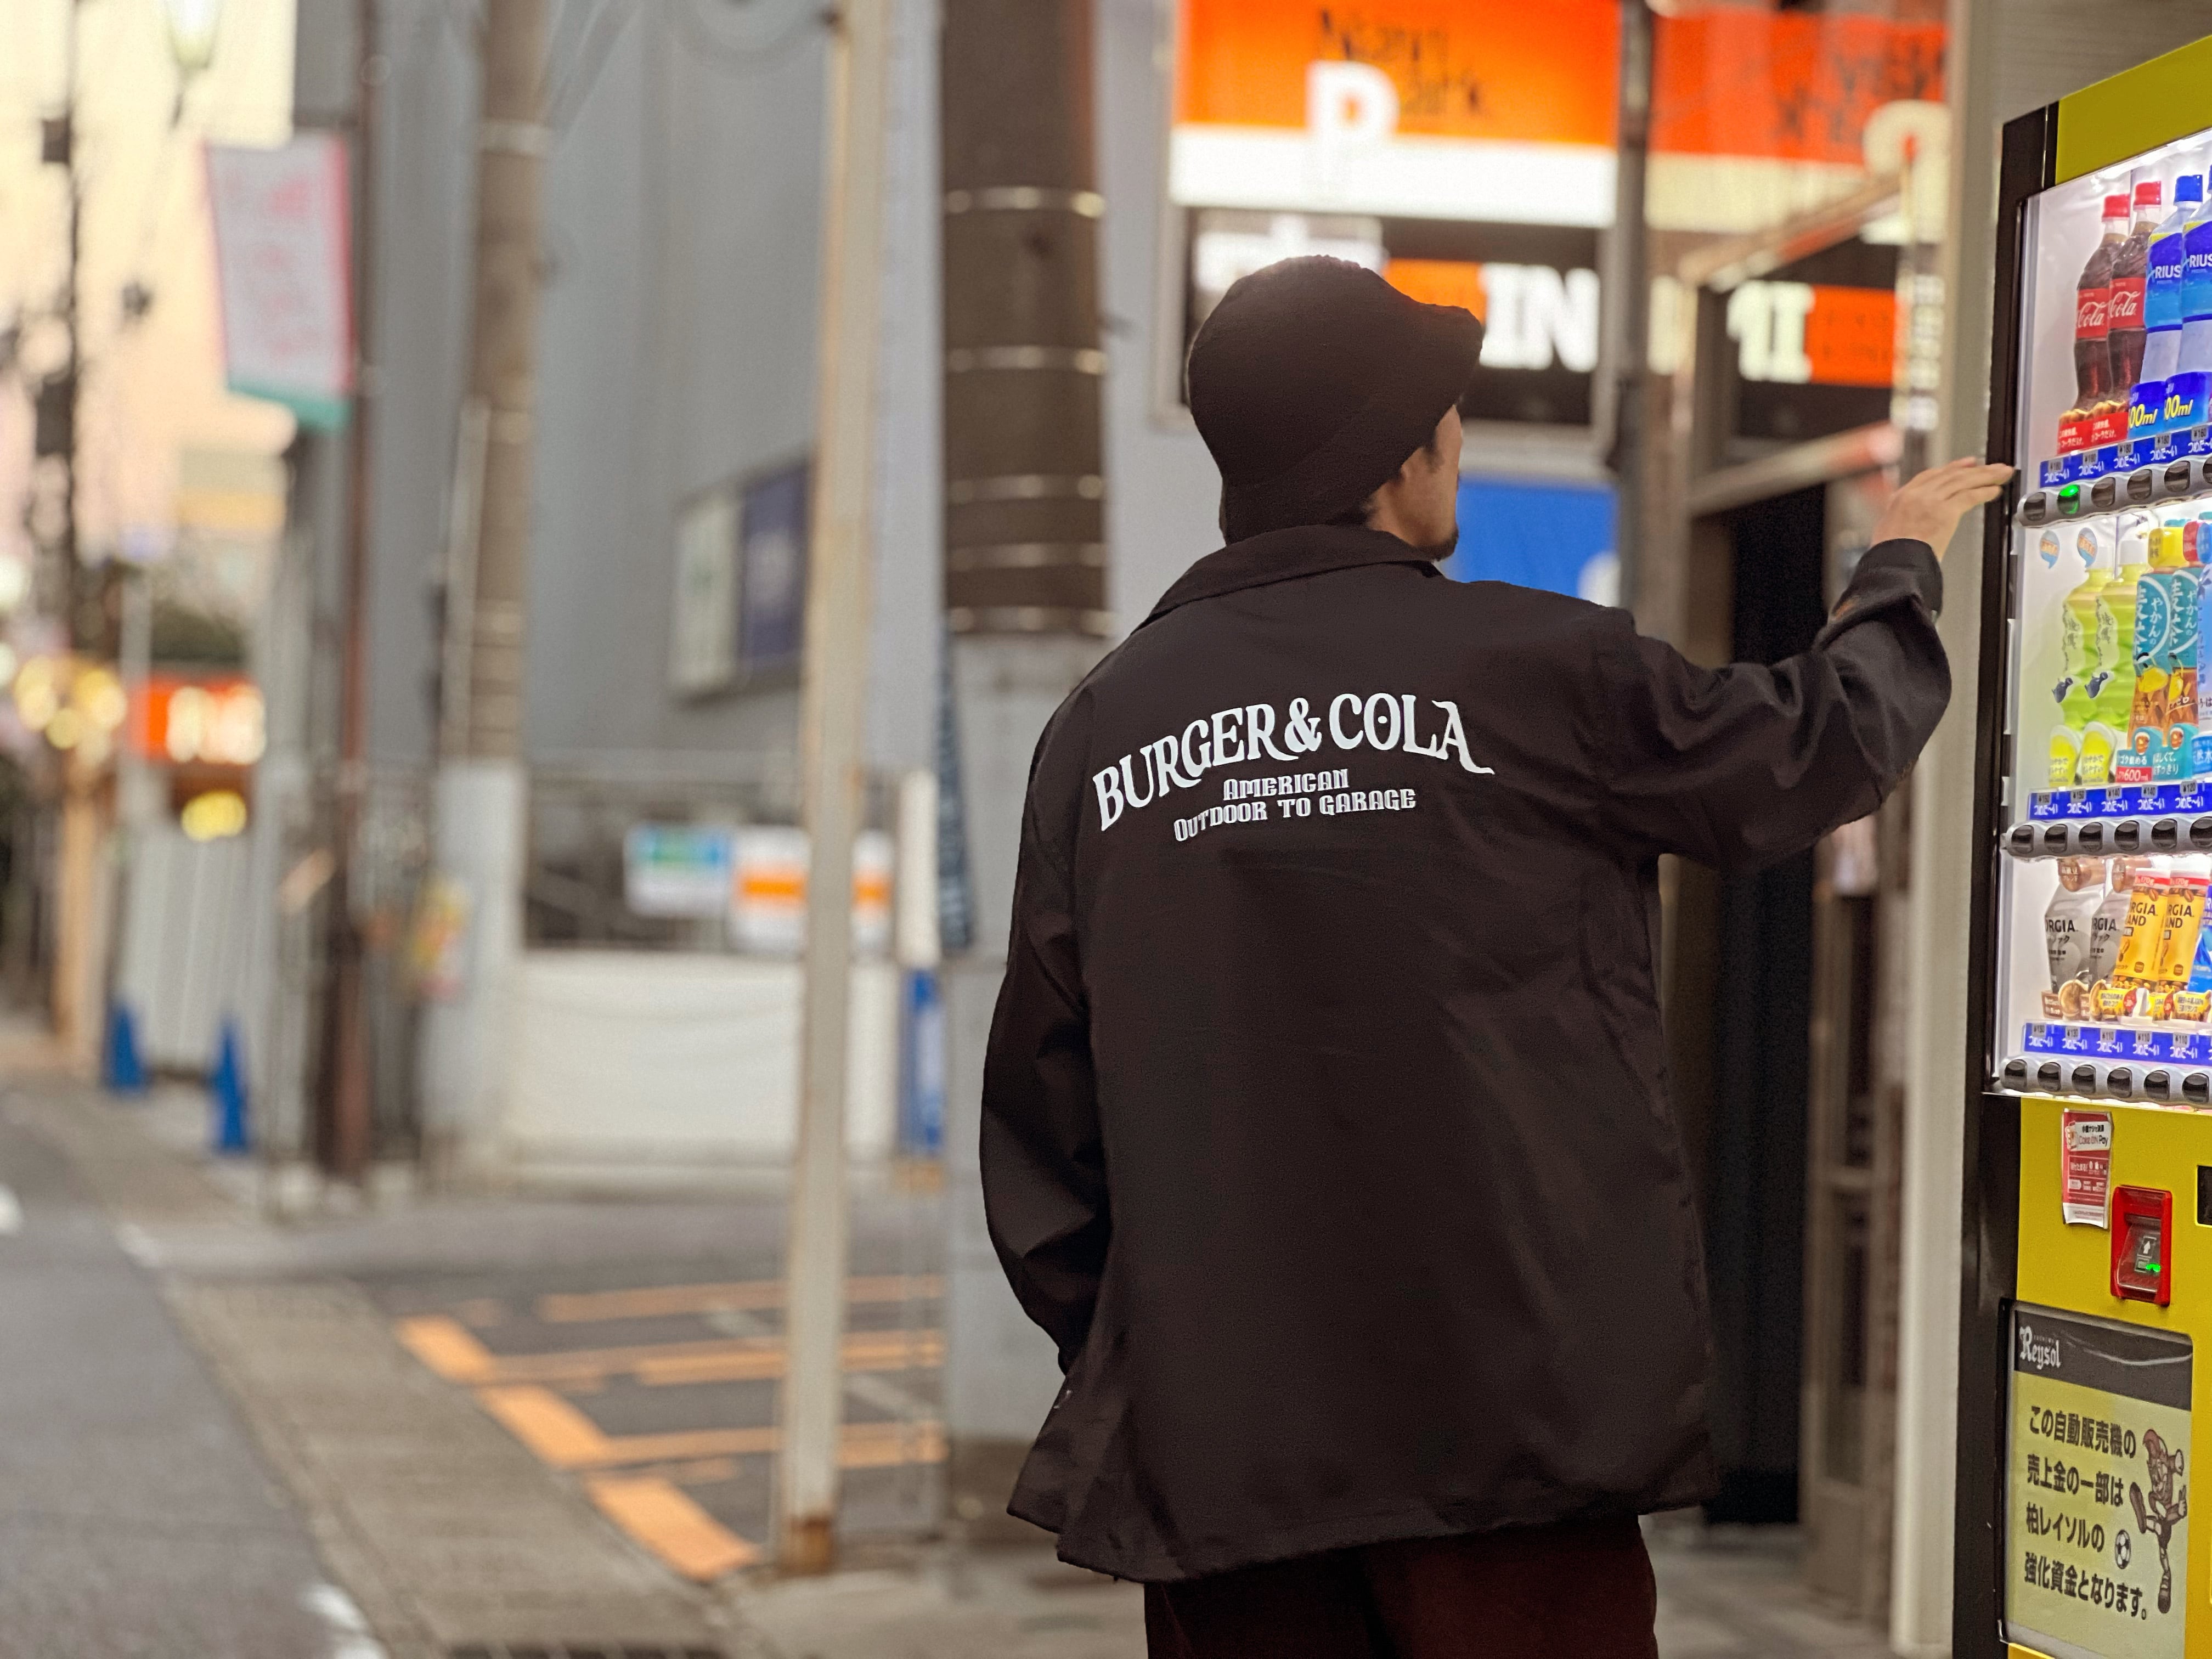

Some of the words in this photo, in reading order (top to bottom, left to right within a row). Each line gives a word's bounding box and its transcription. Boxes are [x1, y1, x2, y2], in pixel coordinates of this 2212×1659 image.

[2148, 597, 2163, 645] やかんの
[1223, 769, 1349, 801] AMERICAN
[1174, 802, 1268, 842] OUTDOOR
[1277, 798, 1311, 818] TO
[1319, 788, 1417, 816] GARAGE
[2098, 1135, 2108, 1147] Pay
[2019, 1325, 2061, 1369] Reysol
[2030, 1406, 2136, 1459] この自動販売機の
[2027, 1454, 2124, 1506] 売上金の一部は
[2026, 1502, 2104, 1553] 柏レイソルの
[2024, 1551, 2147, 1620] 強化資金となります。
